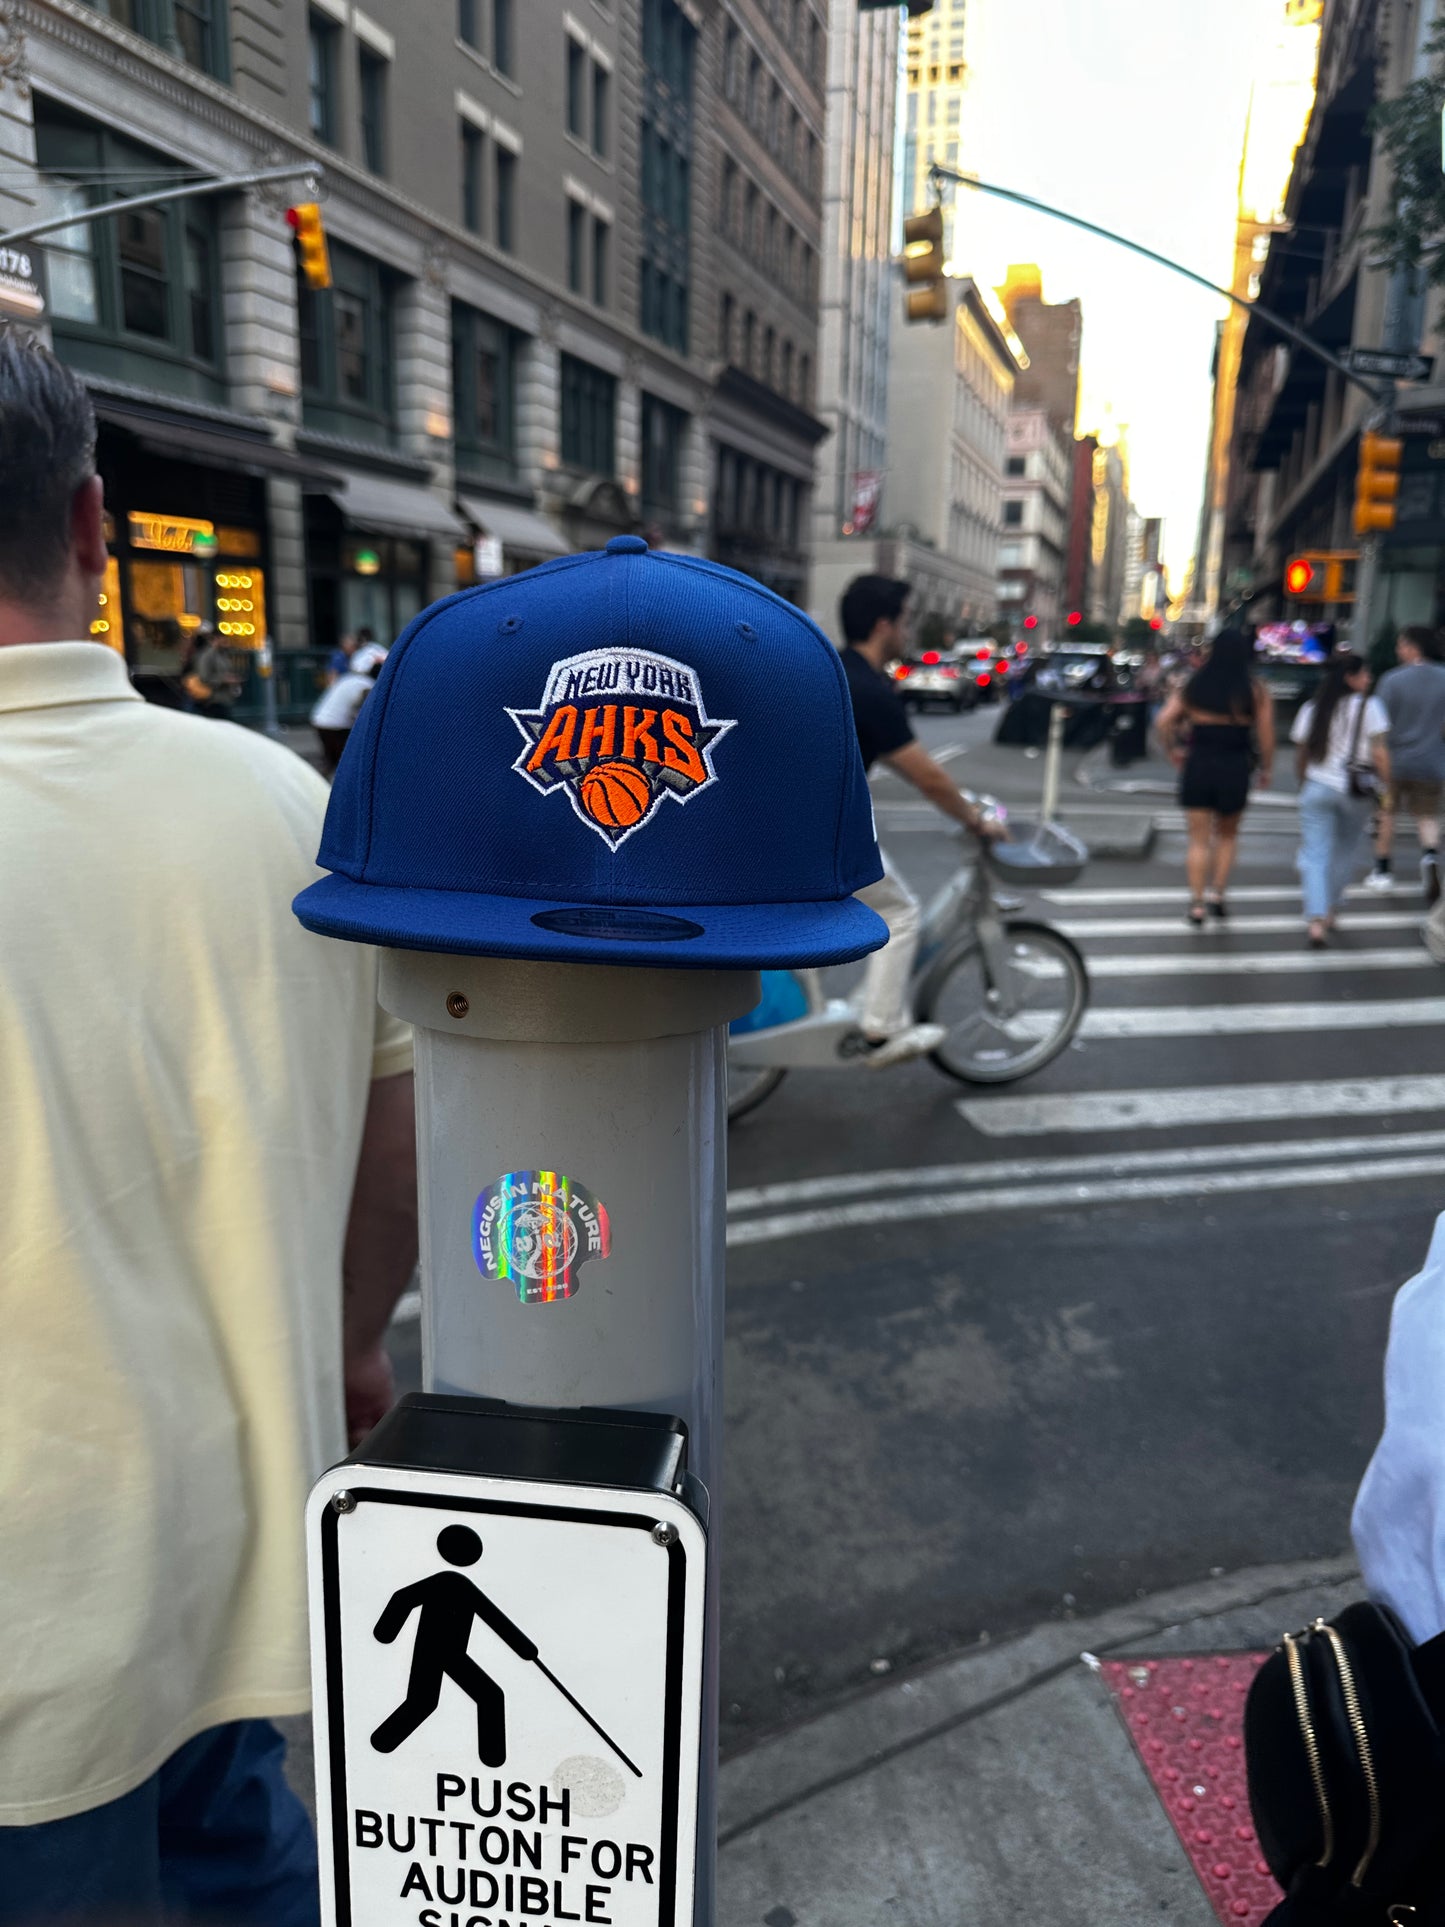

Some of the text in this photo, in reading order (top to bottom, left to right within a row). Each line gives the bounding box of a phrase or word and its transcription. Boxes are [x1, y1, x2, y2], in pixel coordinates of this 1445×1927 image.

[564, 662, 692, 700] NEW YORK
[526, 704, 707, 784] AHKS
[479, 1182, 600, 1271] NEGUS IN NATURE
[437, 1772, 570, 1827] PUSH
[355, 1809, 654, 1884] BUTTON FOR
[400, 1862, 612, 1925] AUDIBLE
